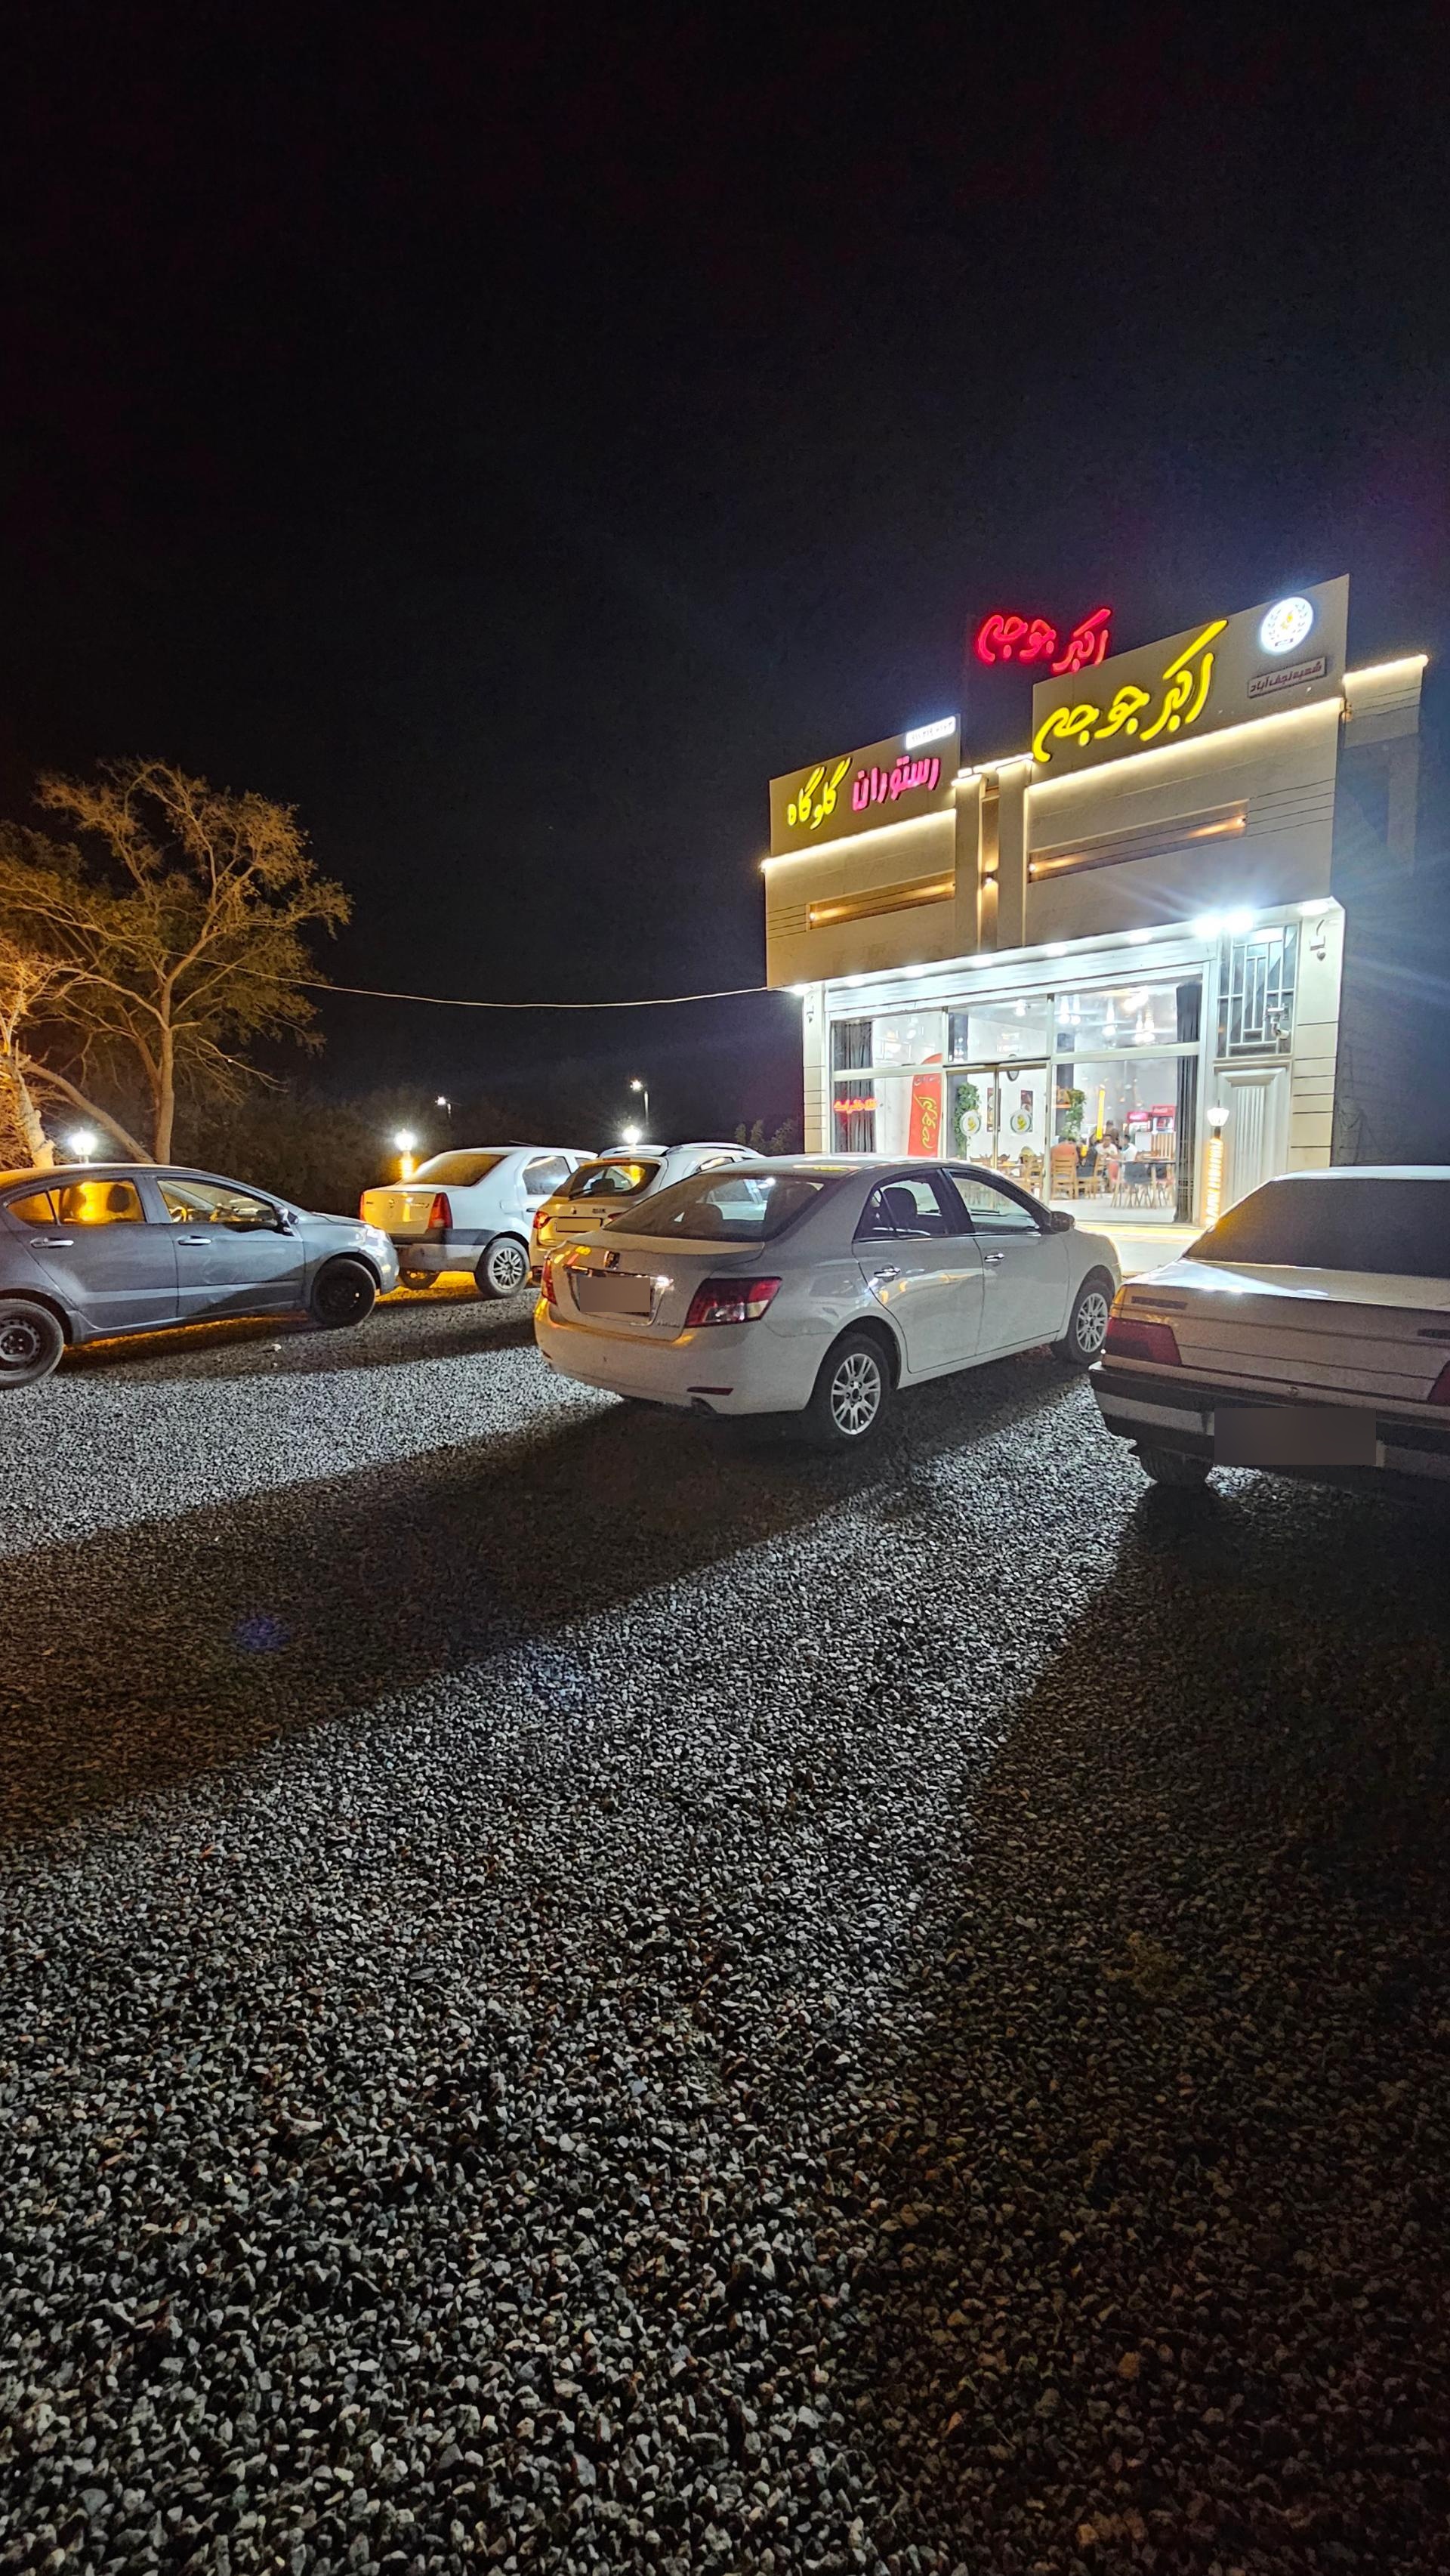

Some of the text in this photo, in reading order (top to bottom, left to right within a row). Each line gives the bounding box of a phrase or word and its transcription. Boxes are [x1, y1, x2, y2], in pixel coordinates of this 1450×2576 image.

[978, 608, 1111, 673] اکبر جوجه
[1032, 619, 1228, 763] اکبر جوجه
[787, 755, 939, 831] رستوران گلوگاه
